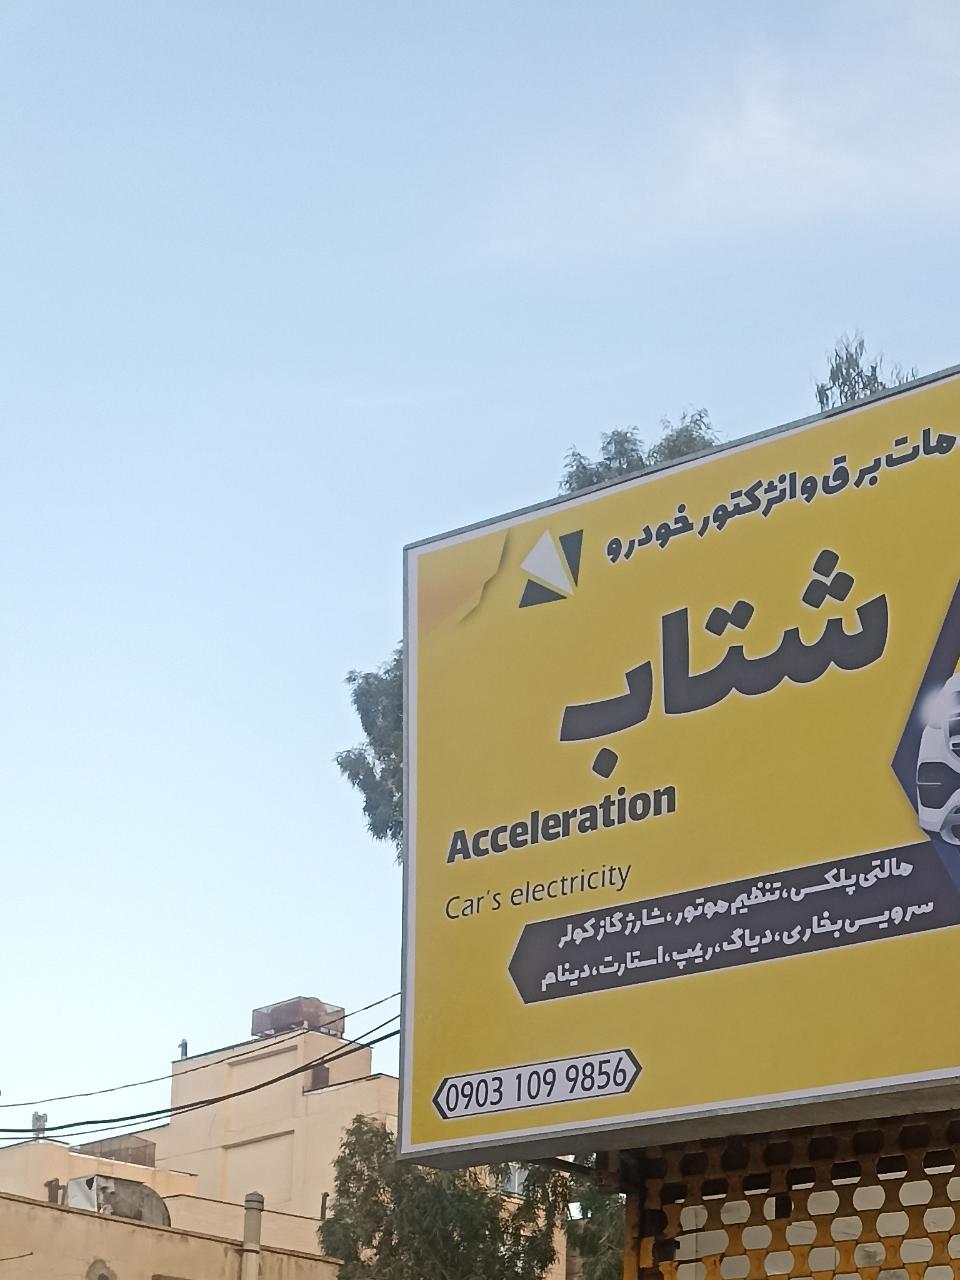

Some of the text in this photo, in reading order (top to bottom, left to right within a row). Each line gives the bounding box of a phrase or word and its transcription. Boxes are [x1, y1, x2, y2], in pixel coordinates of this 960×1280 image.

[822, 455, 882, 495] برق
[698, 472, 797, 537] انژکتور
[607, 503, 694, 563] خودرو
[560, 549, 888, 778] شتاب
[447, 785, 676, 863] Acceleration
[445, 865, 631, 919] Car's electricity
[844, 901, 934, 933] سرویس
[558, 917, 596, 949] کولر
[624, 907, 665, 935] شارژ
[541, 962, 591, 992] دینام
[445, 1057, 627, 1112] 0903 109 9856
